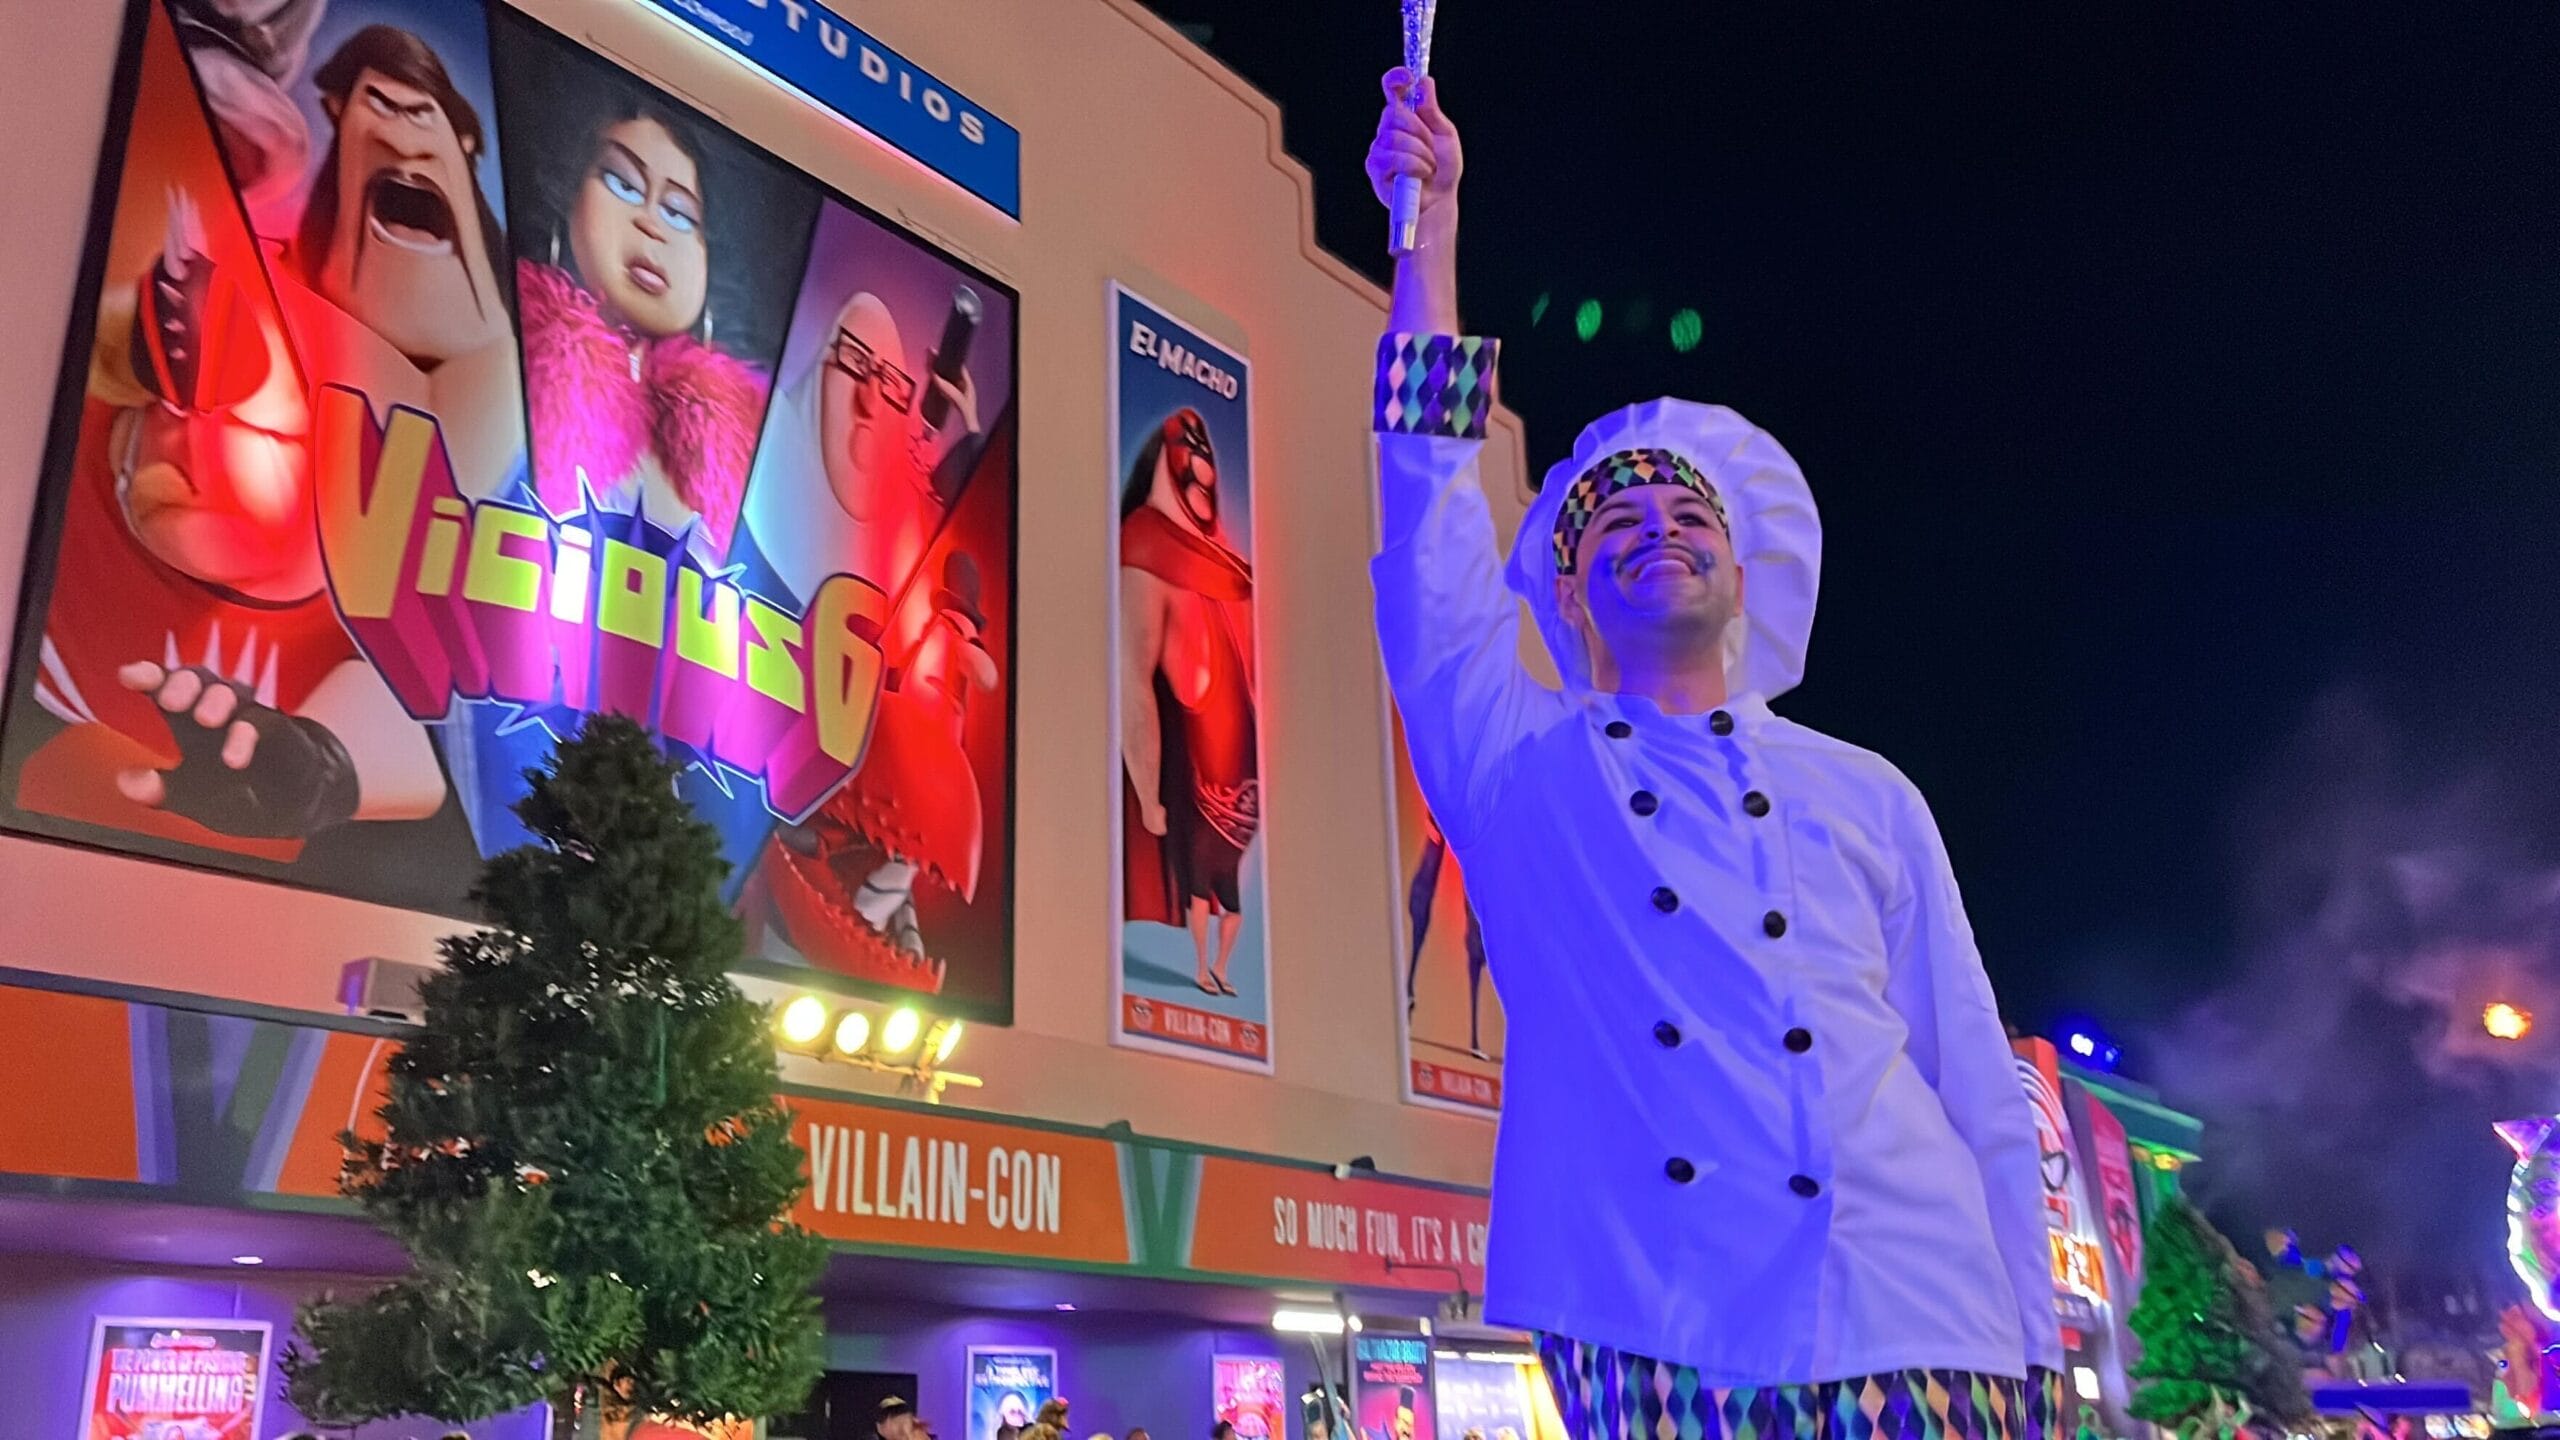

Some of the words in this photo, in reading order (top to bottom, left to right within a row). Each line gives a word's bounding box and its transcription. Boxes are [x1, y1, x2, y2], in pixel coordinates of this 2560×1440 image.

[1130, 320, 1158, 357] EL
[1159, 338, 1238, 400] MACHO
[809, 1122, 1060, 1234] VILLAIN-CON
[1273, 1195, 1298, 1246] SO
[1306, 1201, 1358, 1253] MUCH
[1365, 1208, 1405, 1265] FUN,
[1411, 1216, 1445, 1262] IT'S
[1450, 1219, 1462, 1264] A
